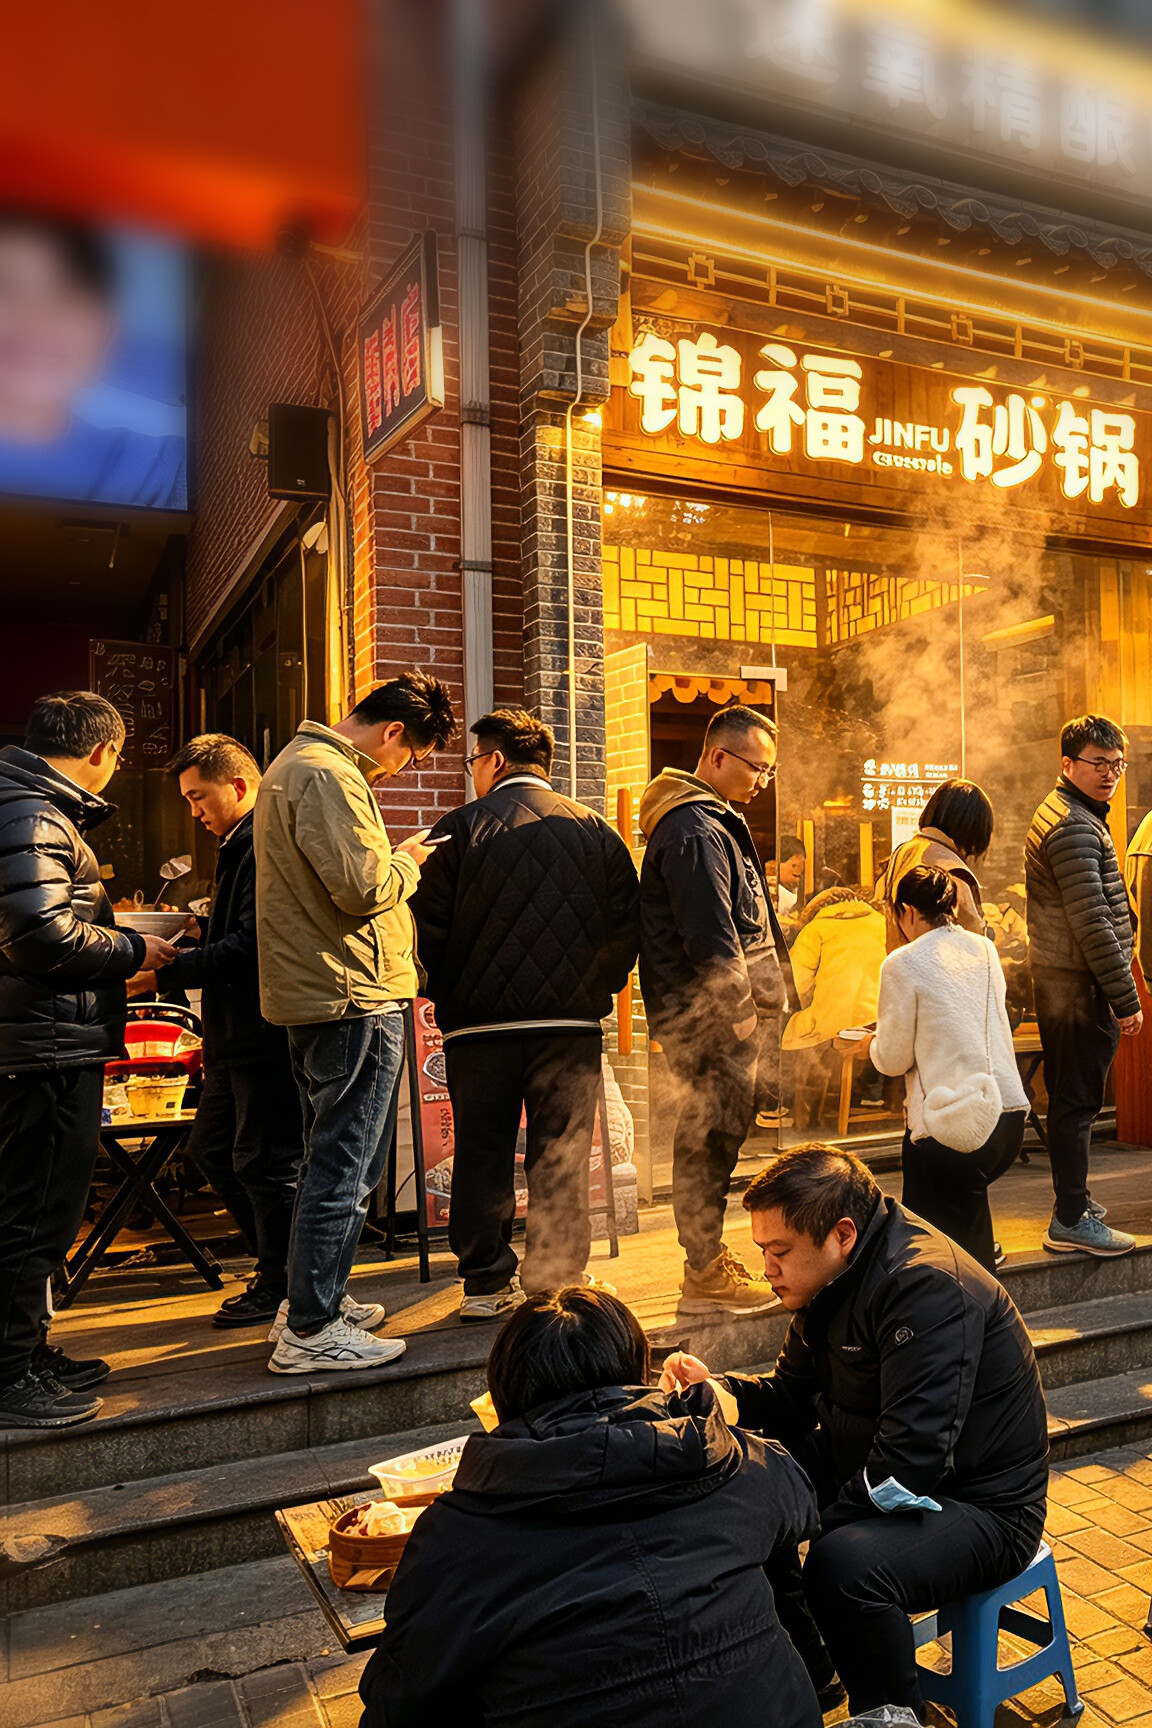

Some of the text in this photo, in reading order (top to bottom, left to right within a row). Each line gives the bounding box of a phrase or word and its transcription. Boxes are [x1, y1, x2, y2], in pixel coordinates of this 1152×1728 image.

[629, 332, 1140, 508] 锦福 砂锅
[869, 417, 950, 453] JINFU
